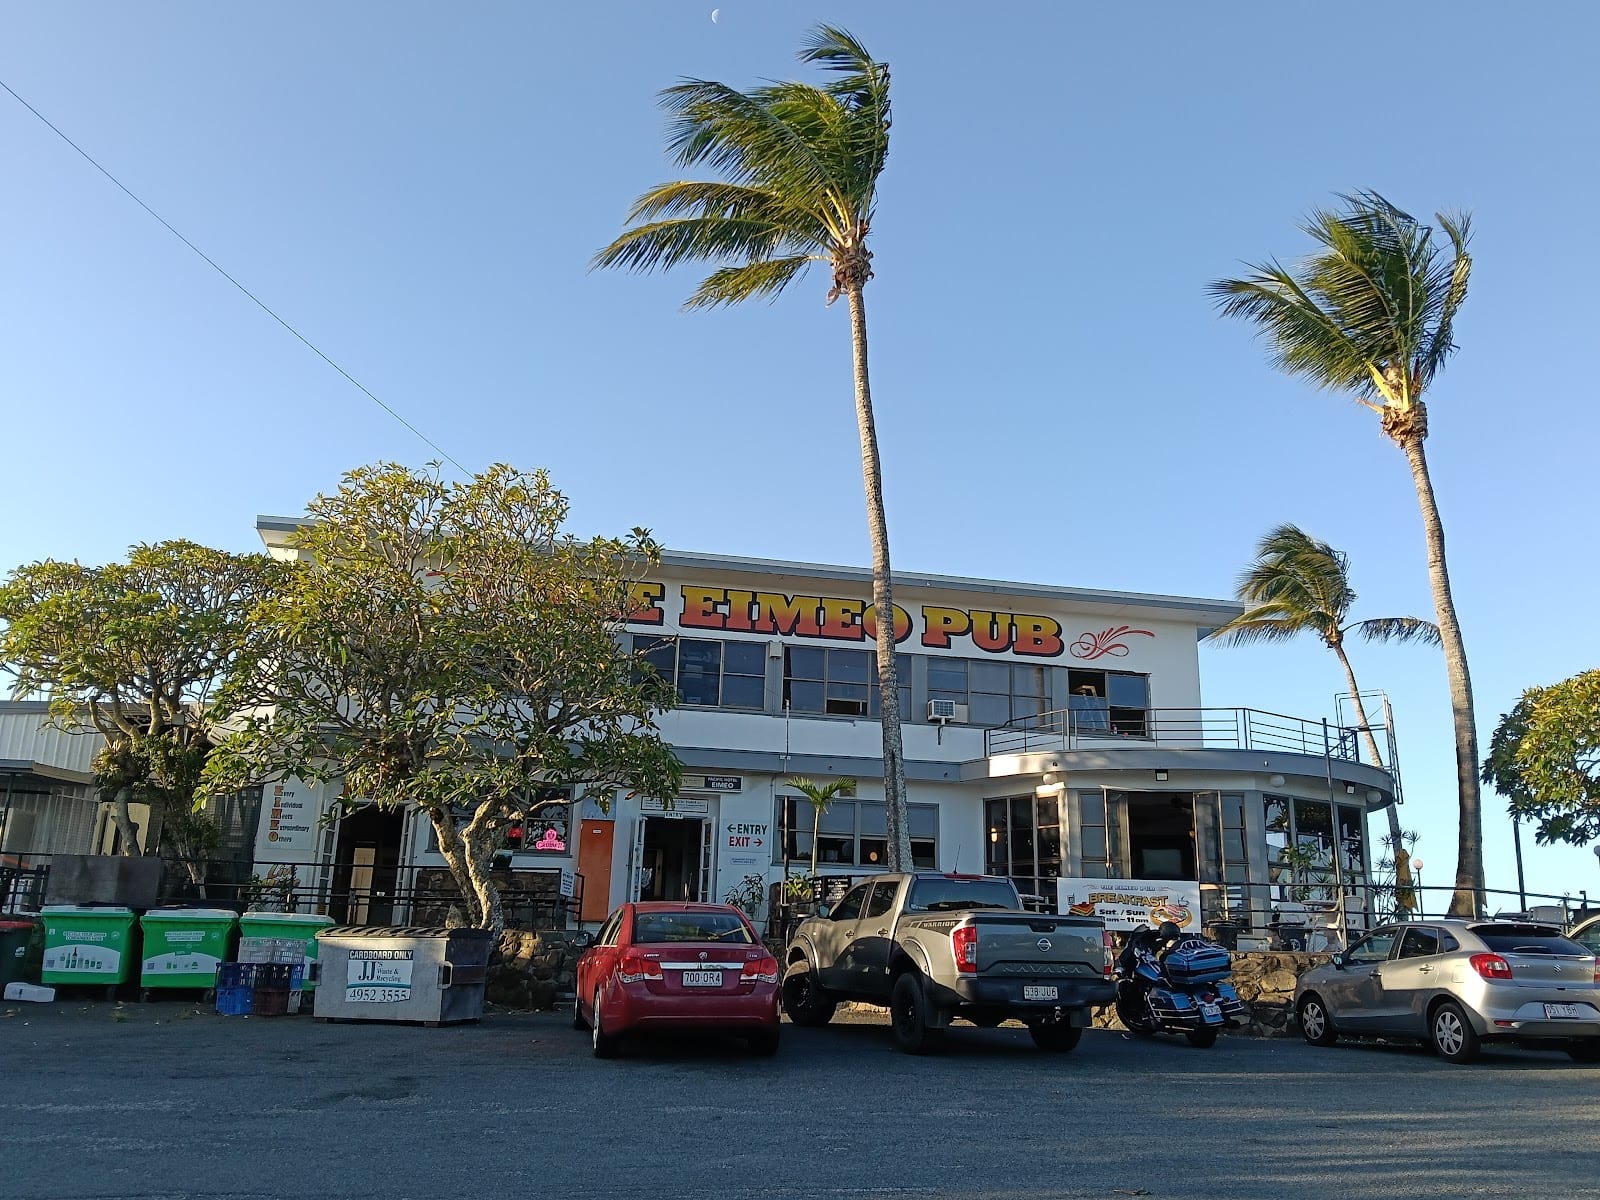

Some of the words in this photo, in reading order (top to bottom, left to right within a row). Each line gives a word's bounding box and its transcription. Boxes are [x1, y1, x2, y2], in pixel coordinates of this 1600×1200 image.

[679, 584, 914, 645] EIMEO
[921, 605, 1065, 657] PUB
[737, 823, 768, 835] ENTRY
[729, 836, 751, 847] EXIT
[1088, 892, 1168, 907] BREAKFAST
[350, 950, 393, 960] CARDBOARD
[394, 950, 413, 960] ONLY
[350, 988, 377, 1001] 4952
[379, 989, 407, 1002] 3555
